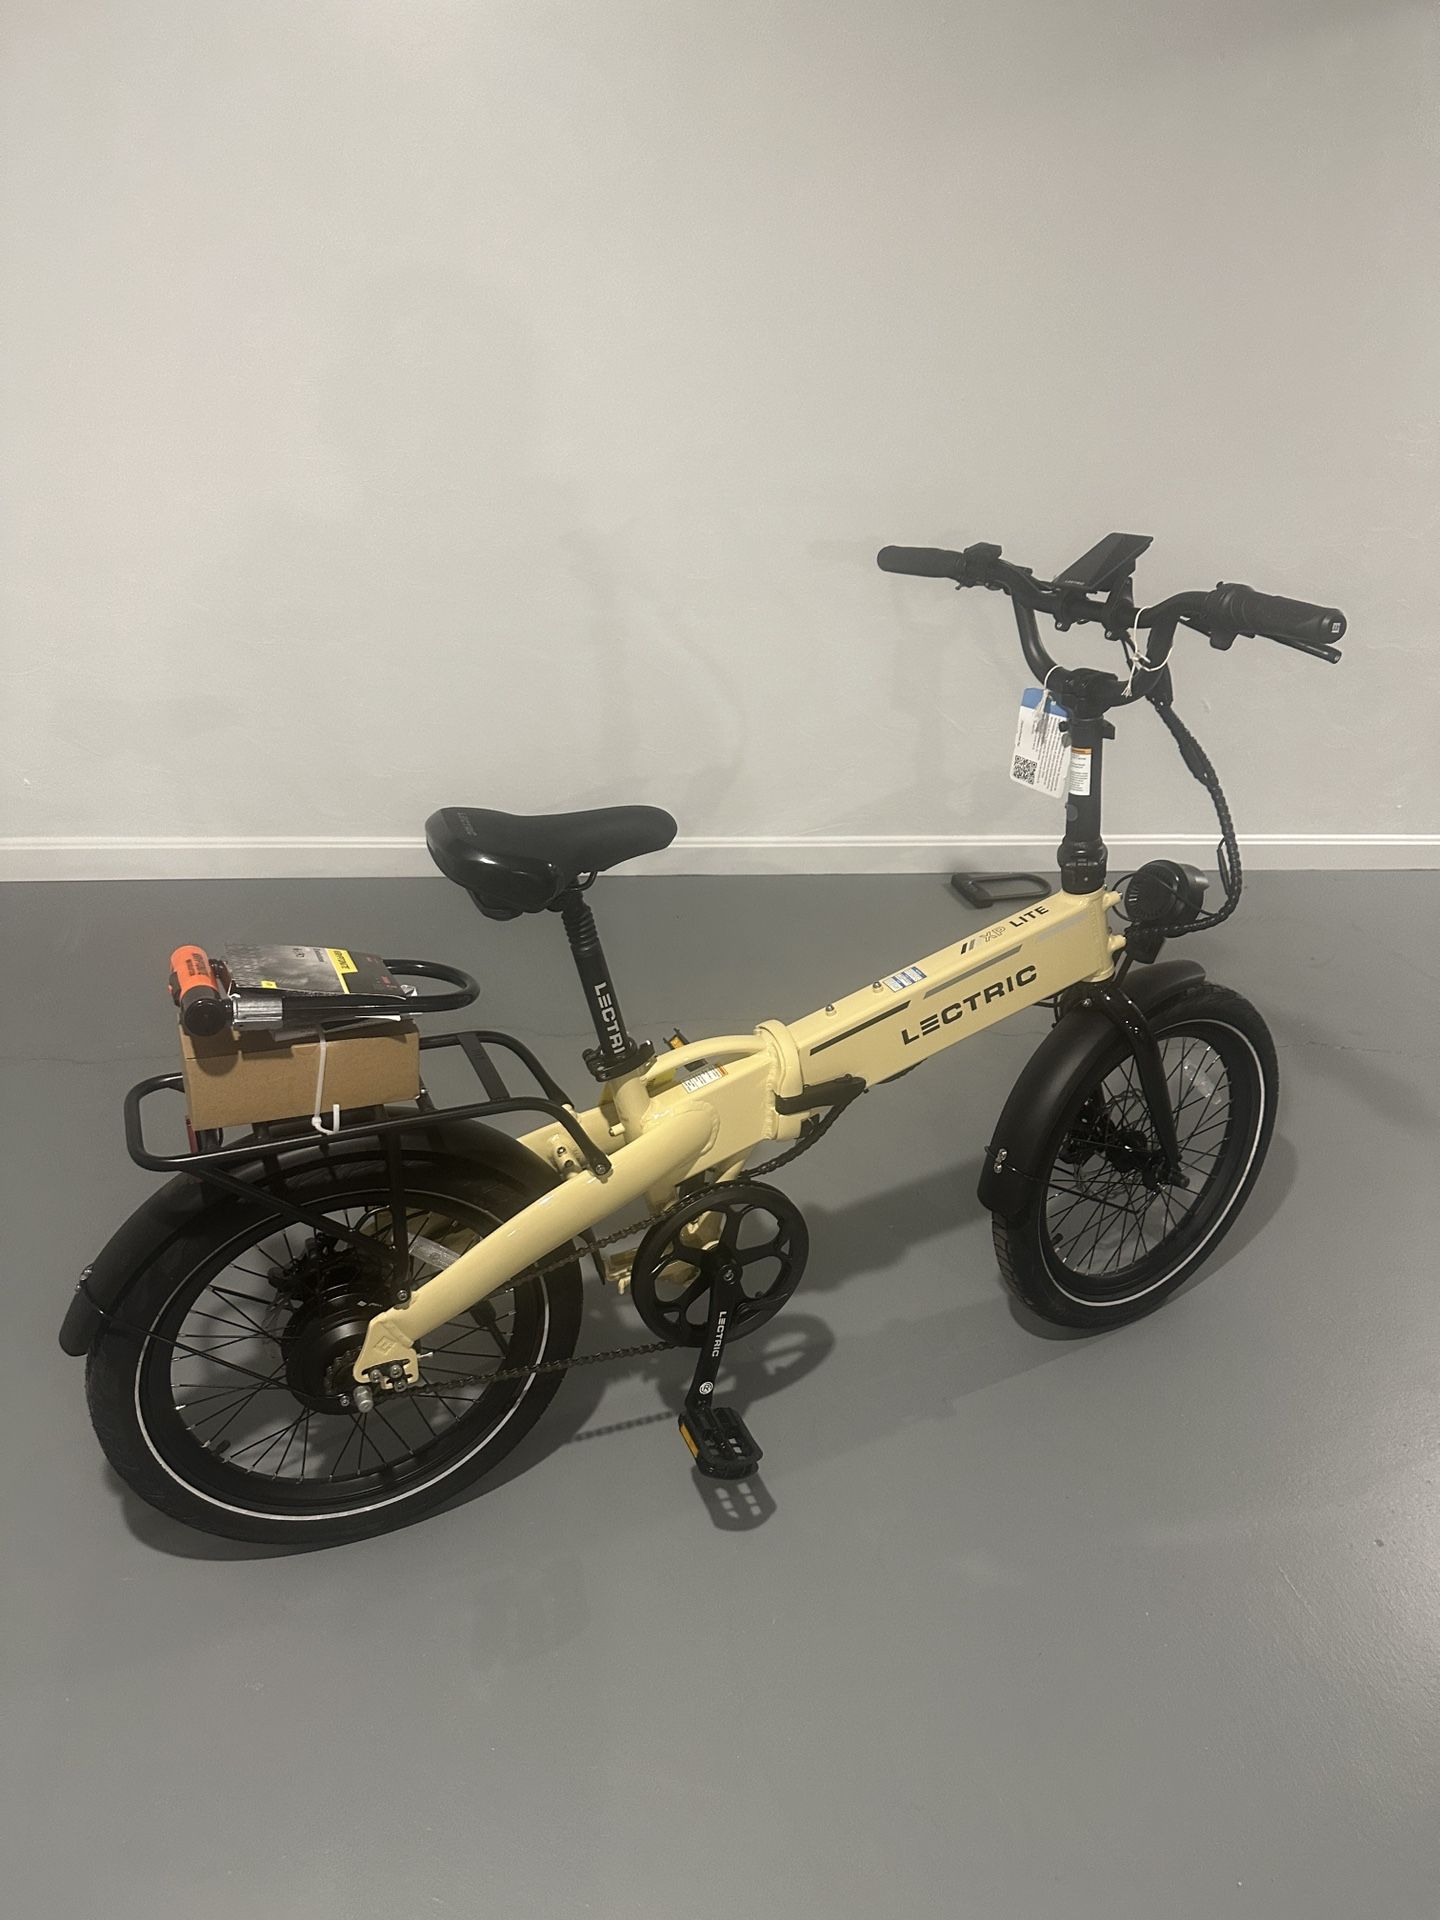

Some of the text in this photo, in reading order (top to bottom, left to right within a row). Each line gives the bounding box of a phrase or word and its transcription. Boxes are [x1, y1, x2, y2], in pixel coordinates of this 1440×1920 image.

[979, 905, 1050, 943] XP LITE
[594, 981, 626, 1055] LECTRI
[901, 964, 1038, 1046] LECTRIC
[712, 1311, 727, 1357] LECTRIC
